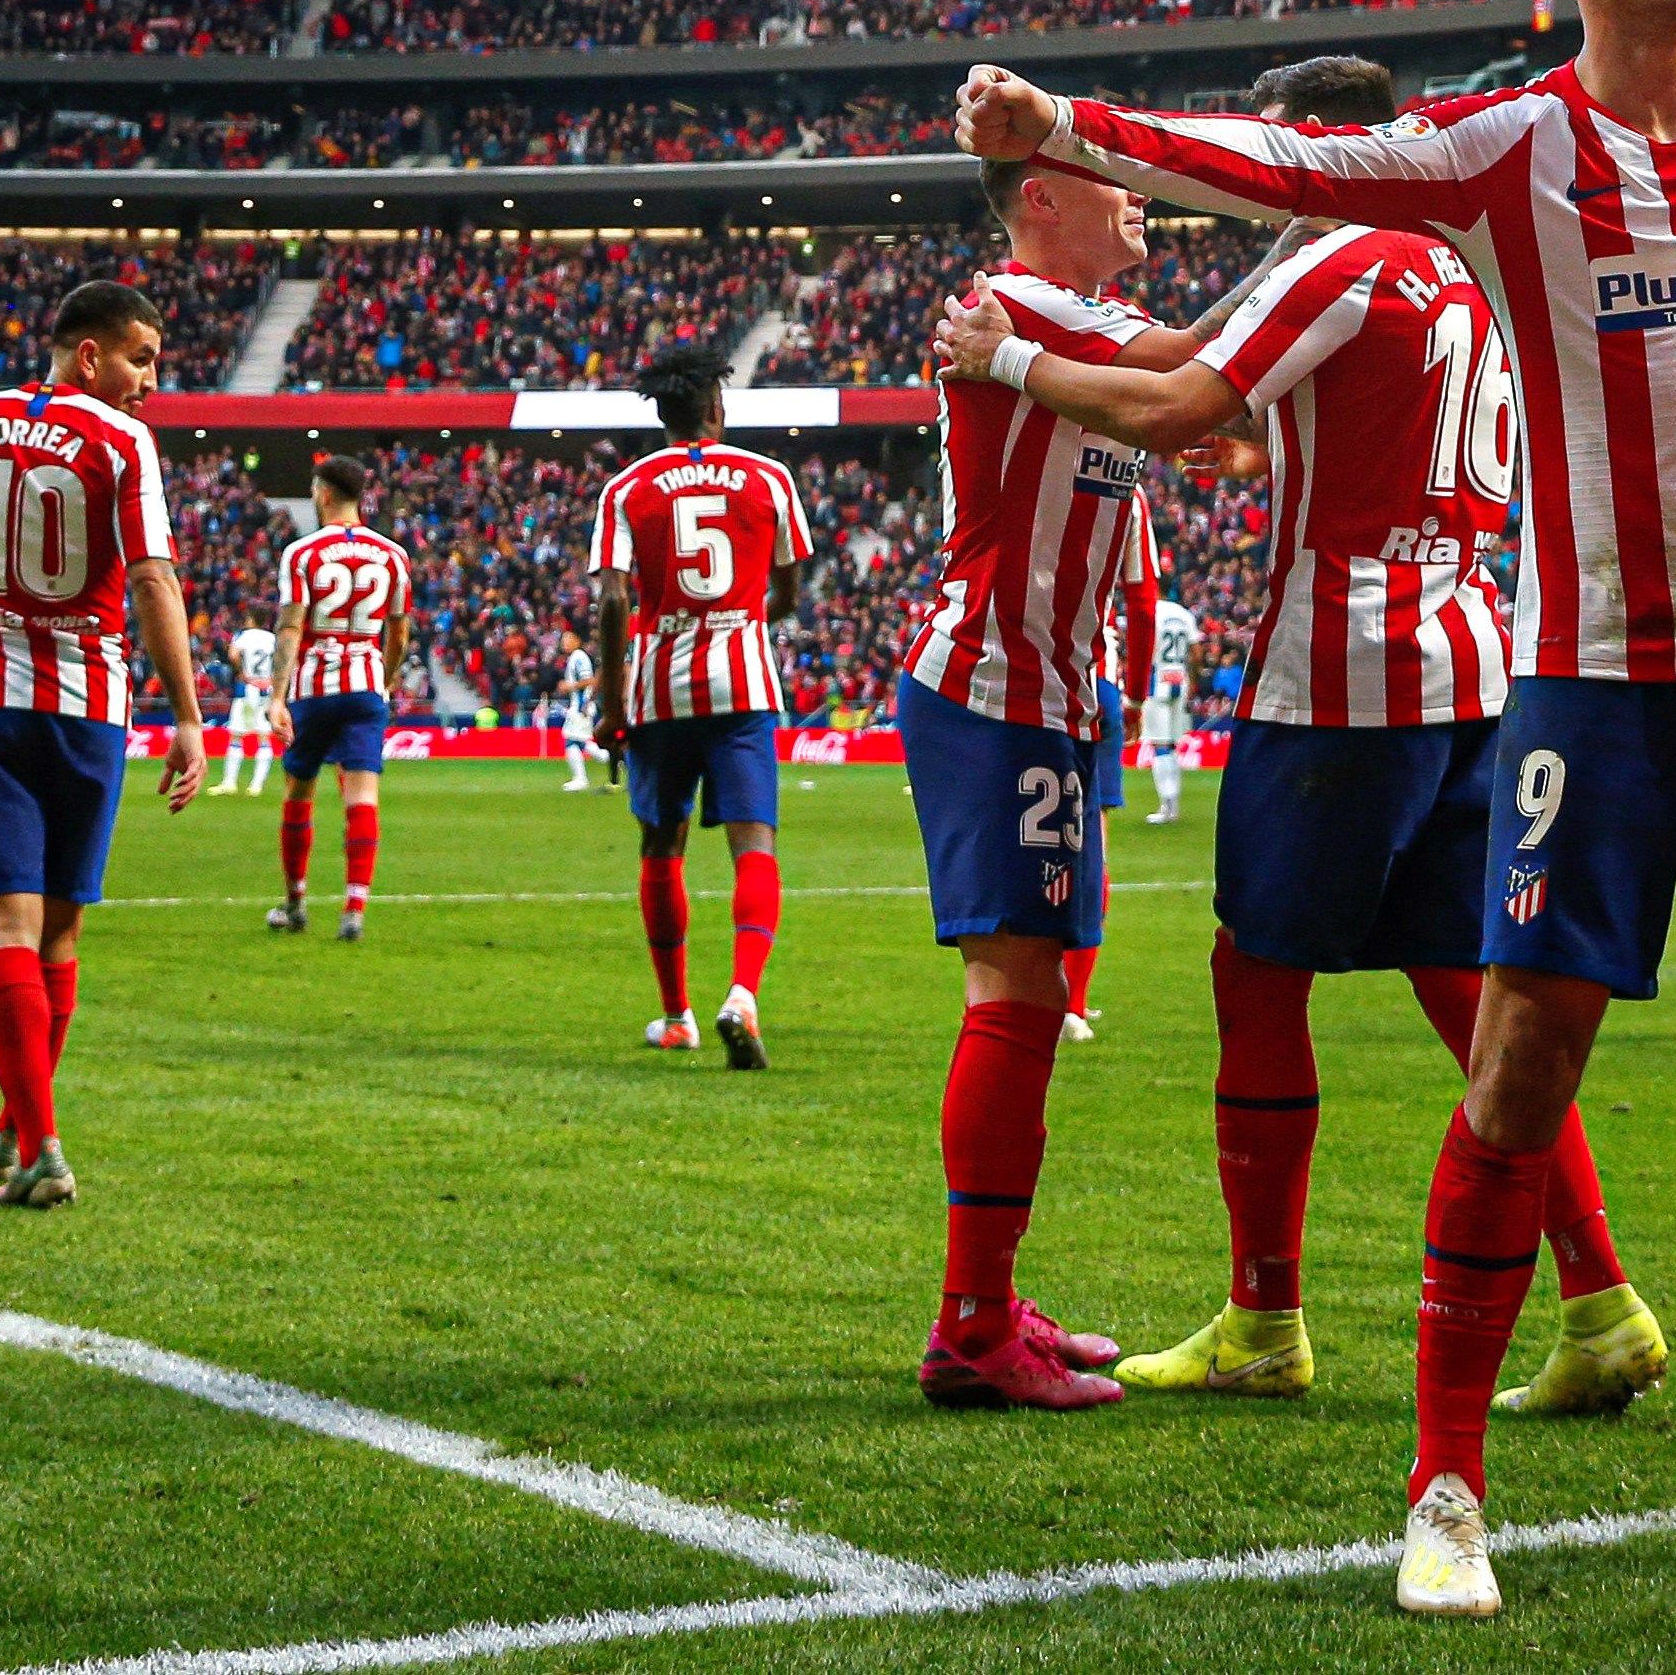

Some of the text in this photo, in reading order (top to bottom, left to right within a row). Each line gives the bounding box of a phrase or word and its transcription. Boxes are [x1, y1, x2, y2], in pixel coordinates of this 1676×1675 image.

[1424, 302, 1519, 505] 16
[652, 463, 748, 495] THOMAS
[672, 494, 734, 601] 5
[1379, 516, 1461, 564] Ria
[312, 562, 391, 635] 22
[1516, 749, 1567, 850] 9
